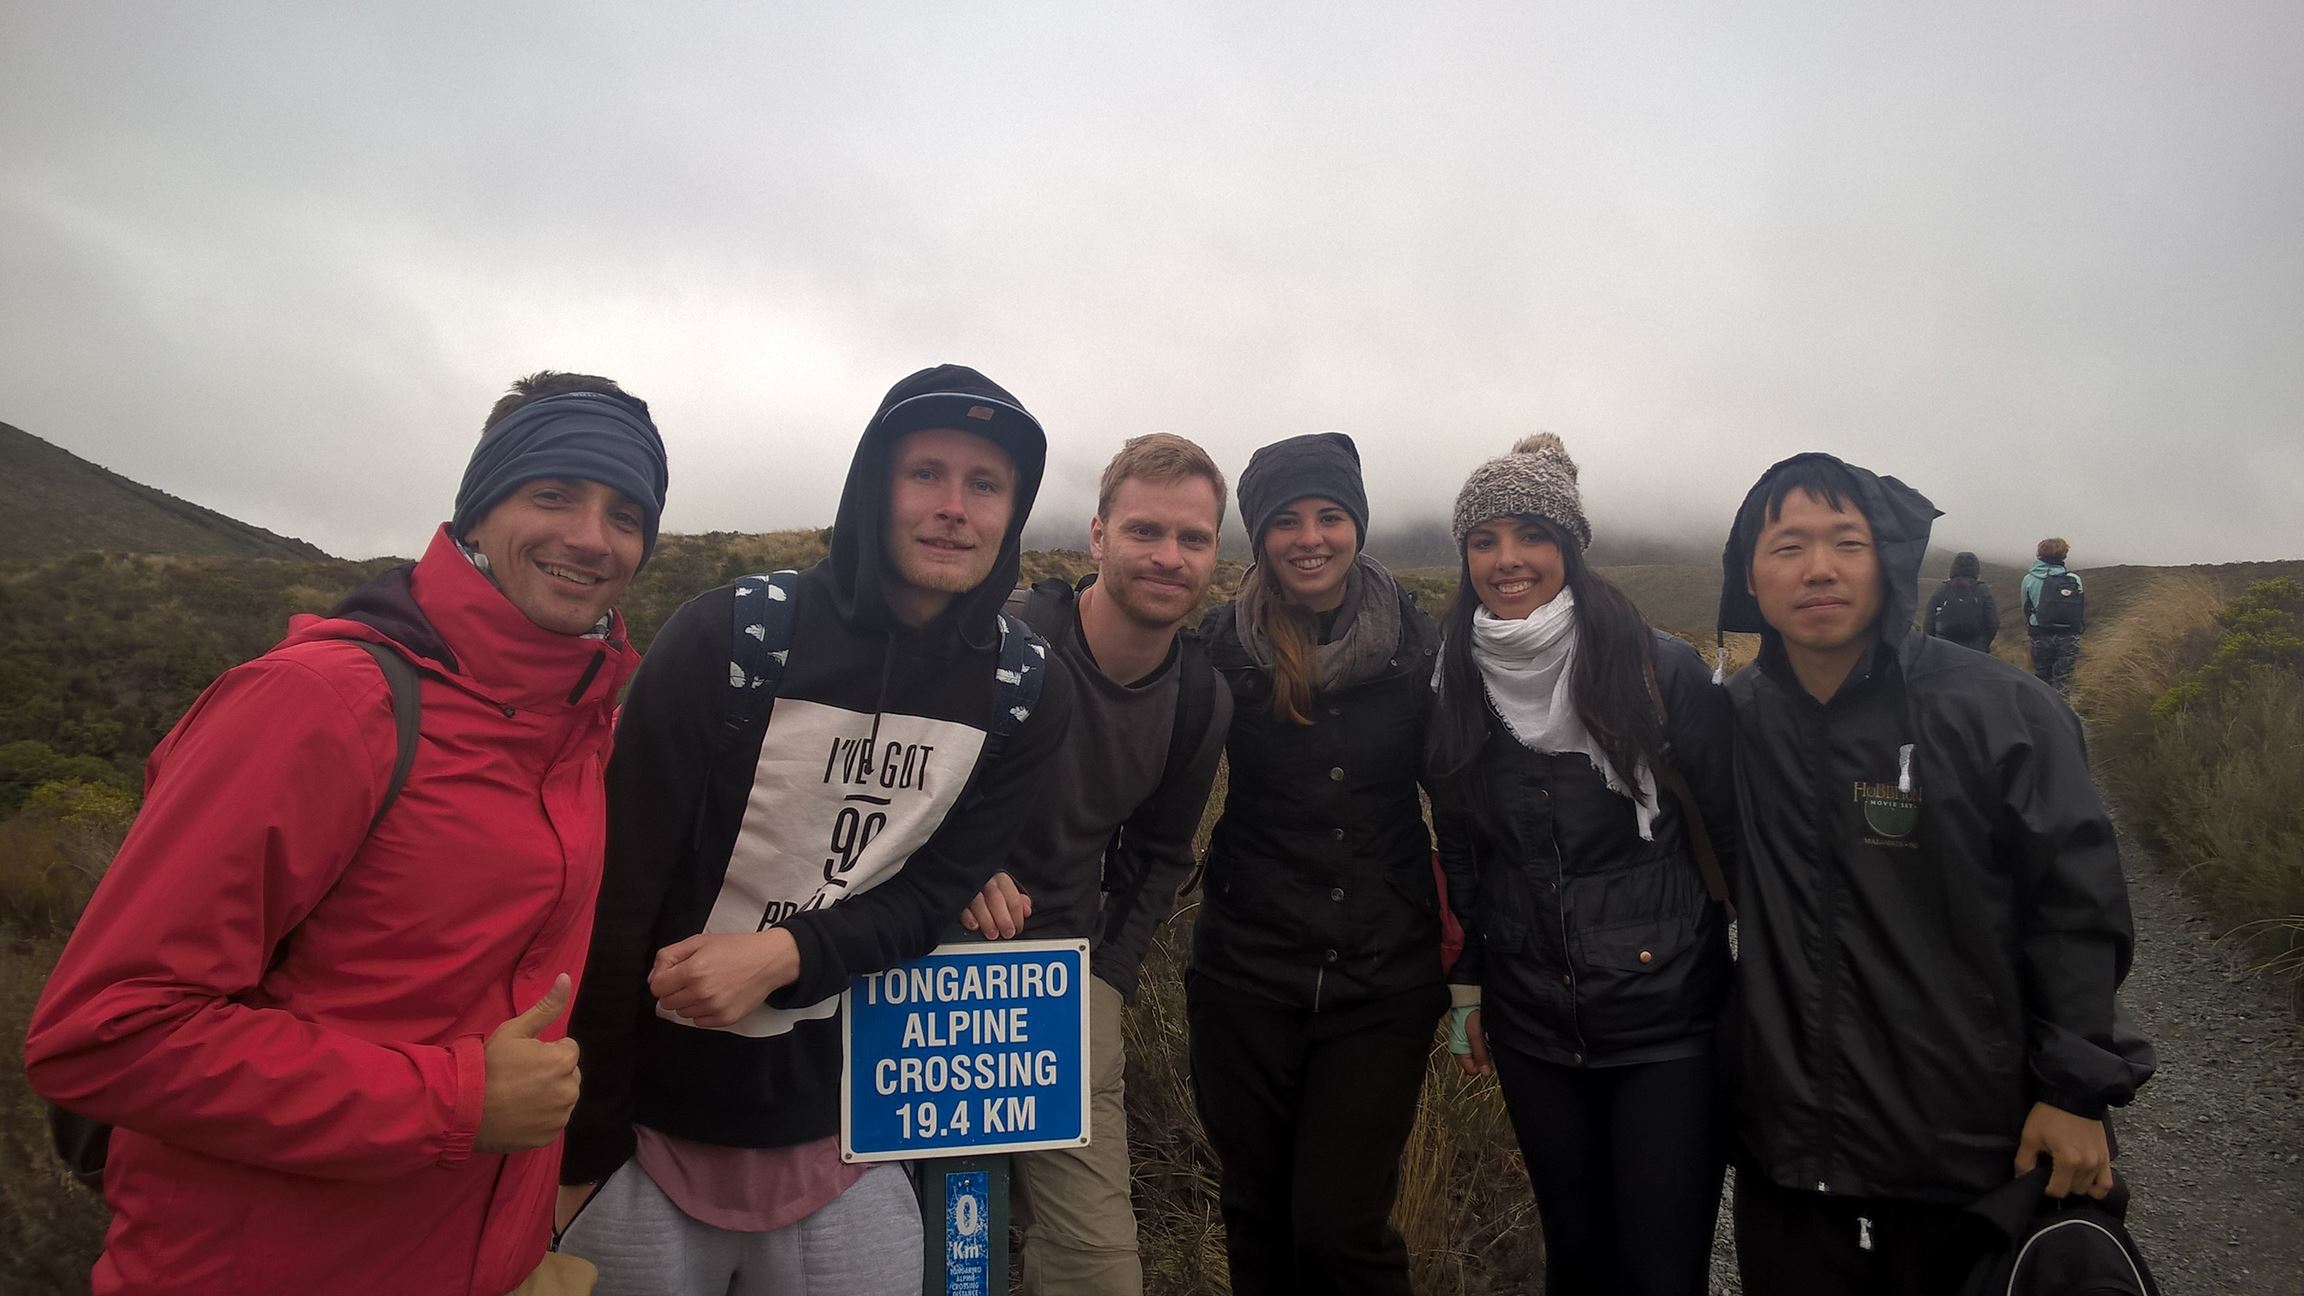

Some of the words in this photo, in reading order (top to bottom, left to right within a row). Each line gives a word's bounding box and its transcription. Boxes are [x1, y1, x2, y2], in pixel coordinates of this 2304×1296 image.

[880, 741, 934, 790] GOT
[1854, 782, 1922, 801] HOBBION
[862, 961, 1068, 1005] TONGARIRO
[902, 1007, 1028, 1048] ALPINE
[875, 1050, 1058, 1095] CROSSING
[896, 1100, 970, 1139] 19.4
[983, 1096, 1036, 1134] KM
[956, 1194, 978, 1236] 0
[953, 1242, 979, 1260] Km
